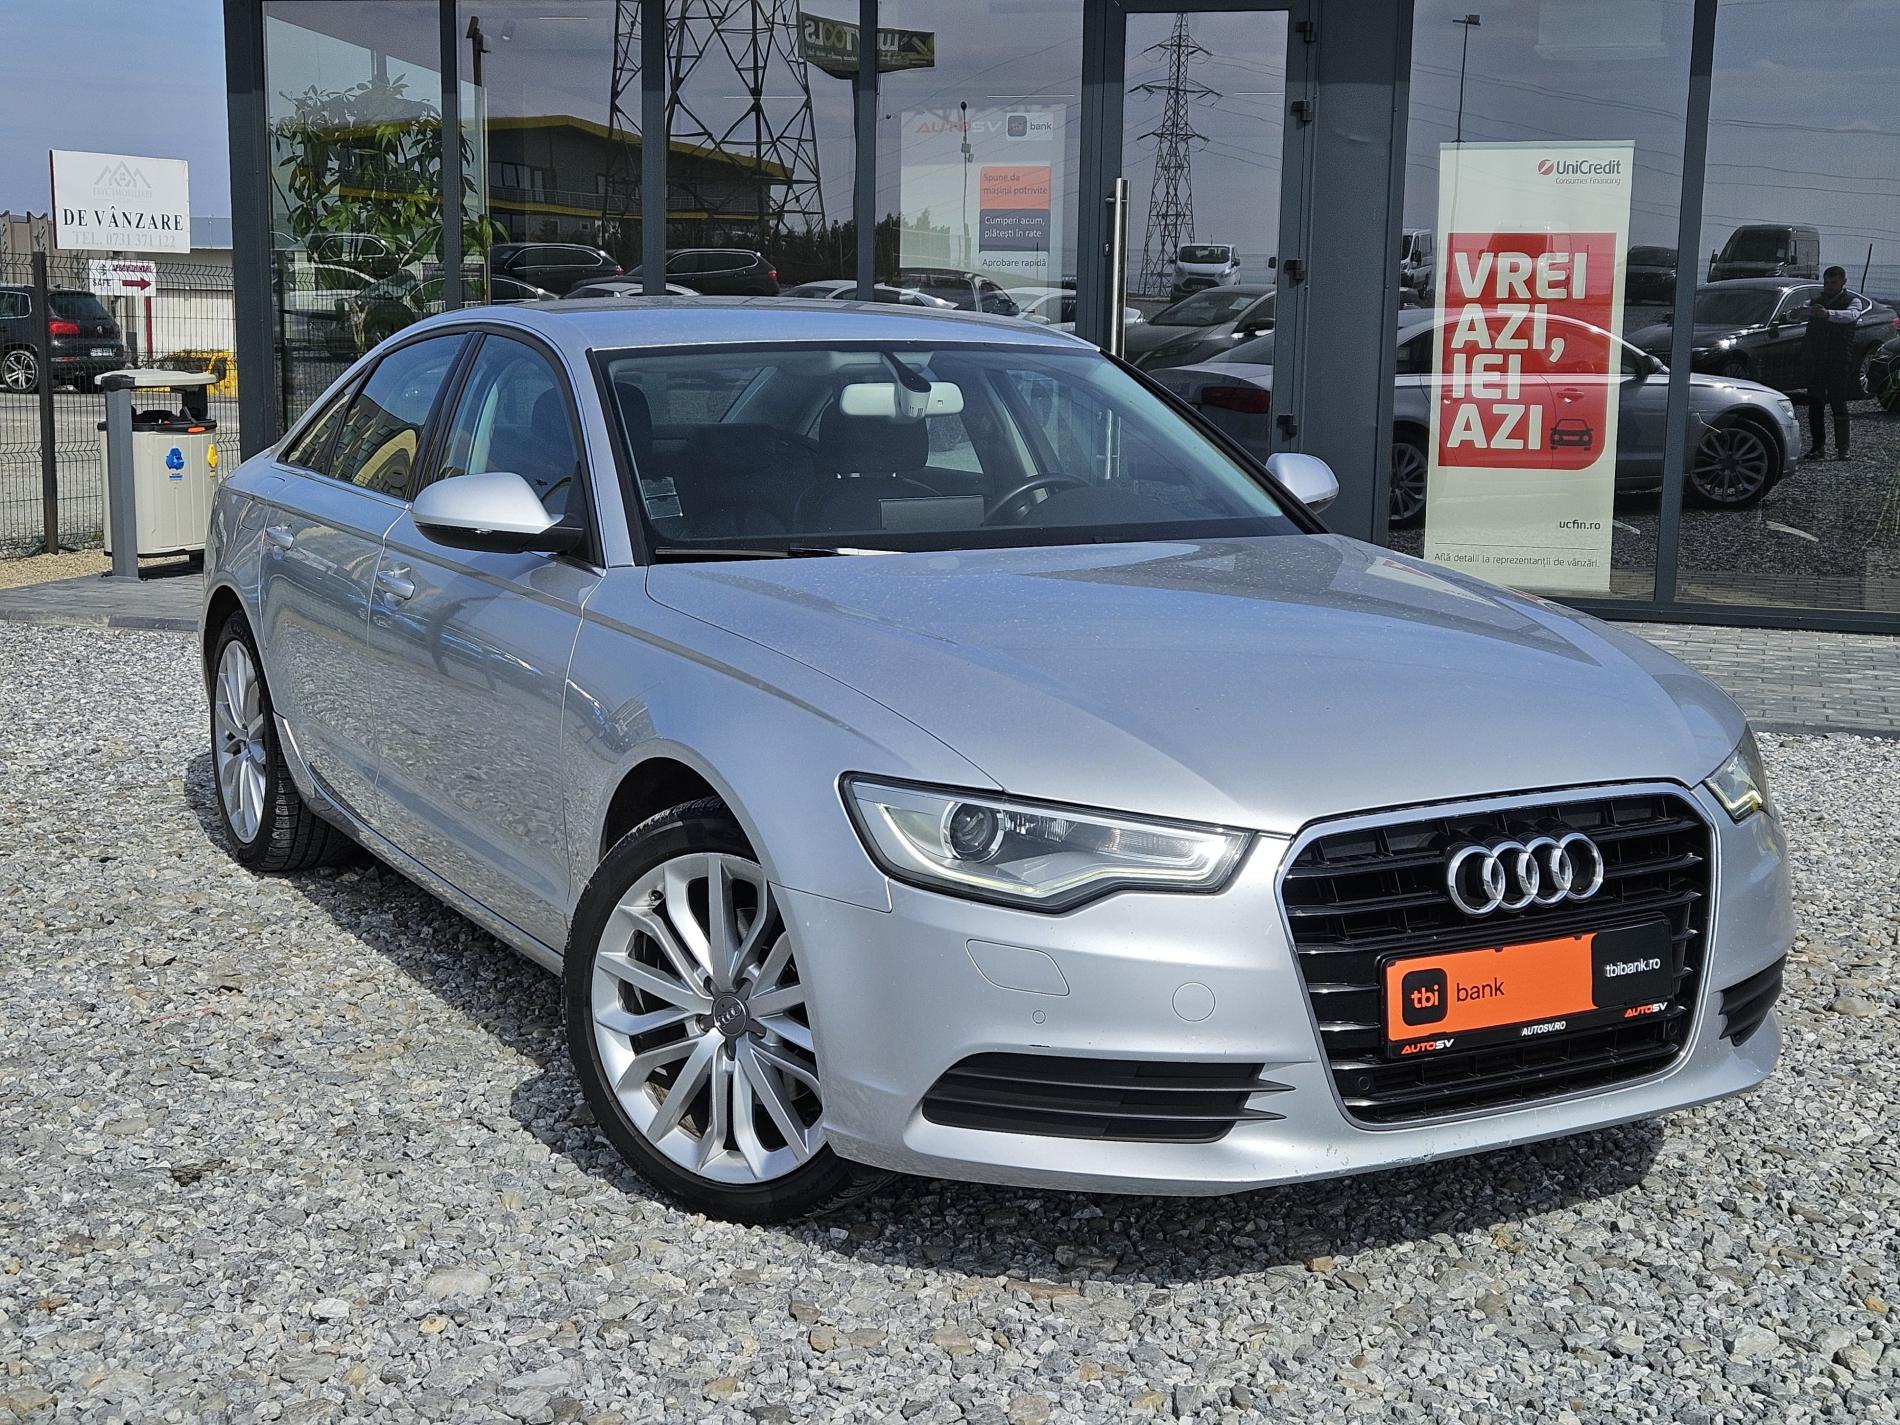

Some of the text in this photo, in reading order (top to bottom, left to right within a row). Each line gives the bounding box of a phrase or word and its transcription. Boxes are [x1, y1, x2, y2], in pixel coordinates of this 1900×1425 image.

[1030, 121, 1052, 131] bank
[1556, 160, 1621, 175] UniCredit
[983, 173, 1021, 184] Spune da
[1589, 177, 1621, 186] Financing
[1013, 186, 1048, 195] potrivite
[63, 205, 184, 231] DE VÂNZARE
[984, 216, 1045, 227] Cumperi acum,
[984, 229, 1042, 239] plătești în rate
[982, 258, 1047, 269] Aprobare rapidă
[1454, 251, 1588, 300] VREI
[1450, 303, 1566, 363] AZI,
[1452, 353, 1523, 400] IEI
[1447, 403, 1543, 450] AZI
[1559, 519, 1601, 530] ucfin.ro
[1434, 552, 1600, 568] Află detalii la reprezentanții de vânzări.
[1604, 957, 1661, 978] tbibank.ro
[1411, 977, 1505, 1009] tbi bank
[1624, 1002, 1668, 1018] AUTOSV
[1521, 1020, 1567, 1037] AUTOSV.RO
[1401, 1038, 1455, 1055] AUTOSV
